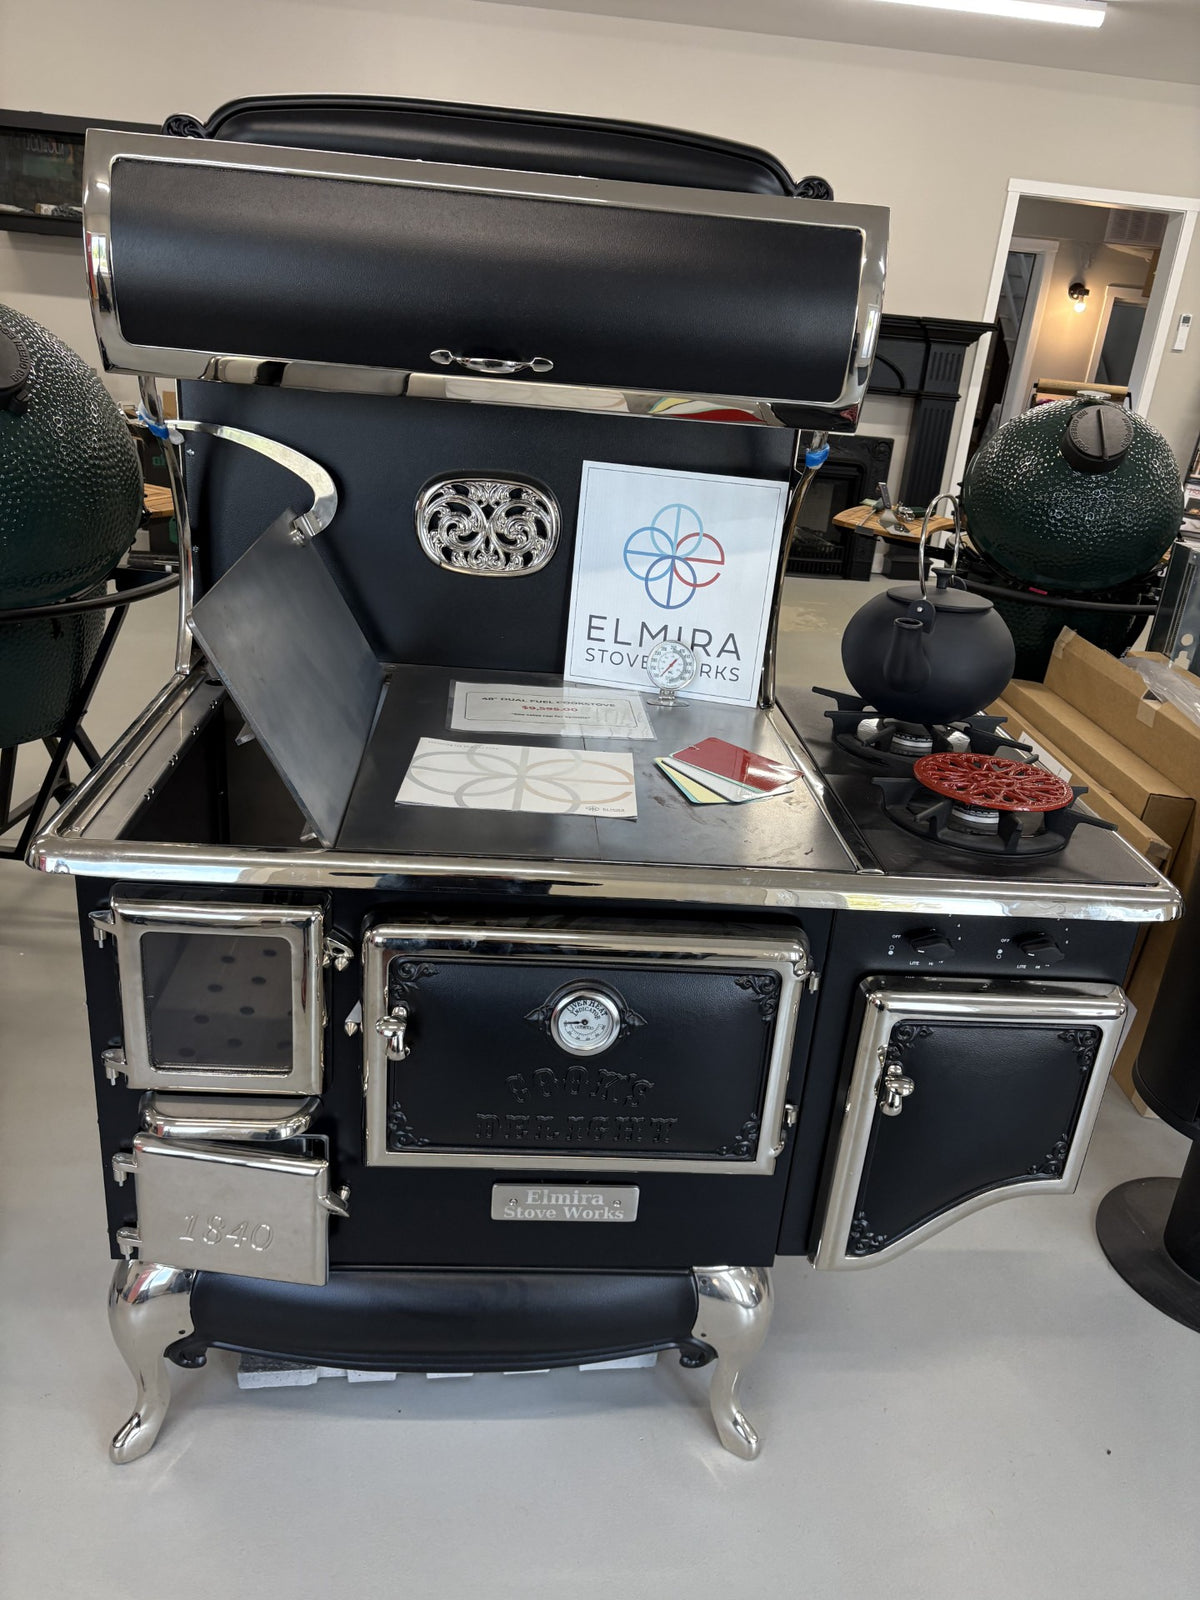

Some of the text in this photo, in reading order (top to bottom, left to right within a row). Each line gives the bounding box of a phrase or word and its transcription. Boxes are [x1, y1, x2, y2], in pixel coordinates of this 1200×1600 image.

[587, 614, 741, 661] ELMIRA
[585, 647, 649, 671] STOVE
[699, 663, 740, 682] RKS
[474, 1113, 679, 1144] DELIGHT
[503, 1206, 625, 1220] Stove Works
[525, 1189, 604, 1206] Elmira
[179, 1215, 274, 1252] 1840
